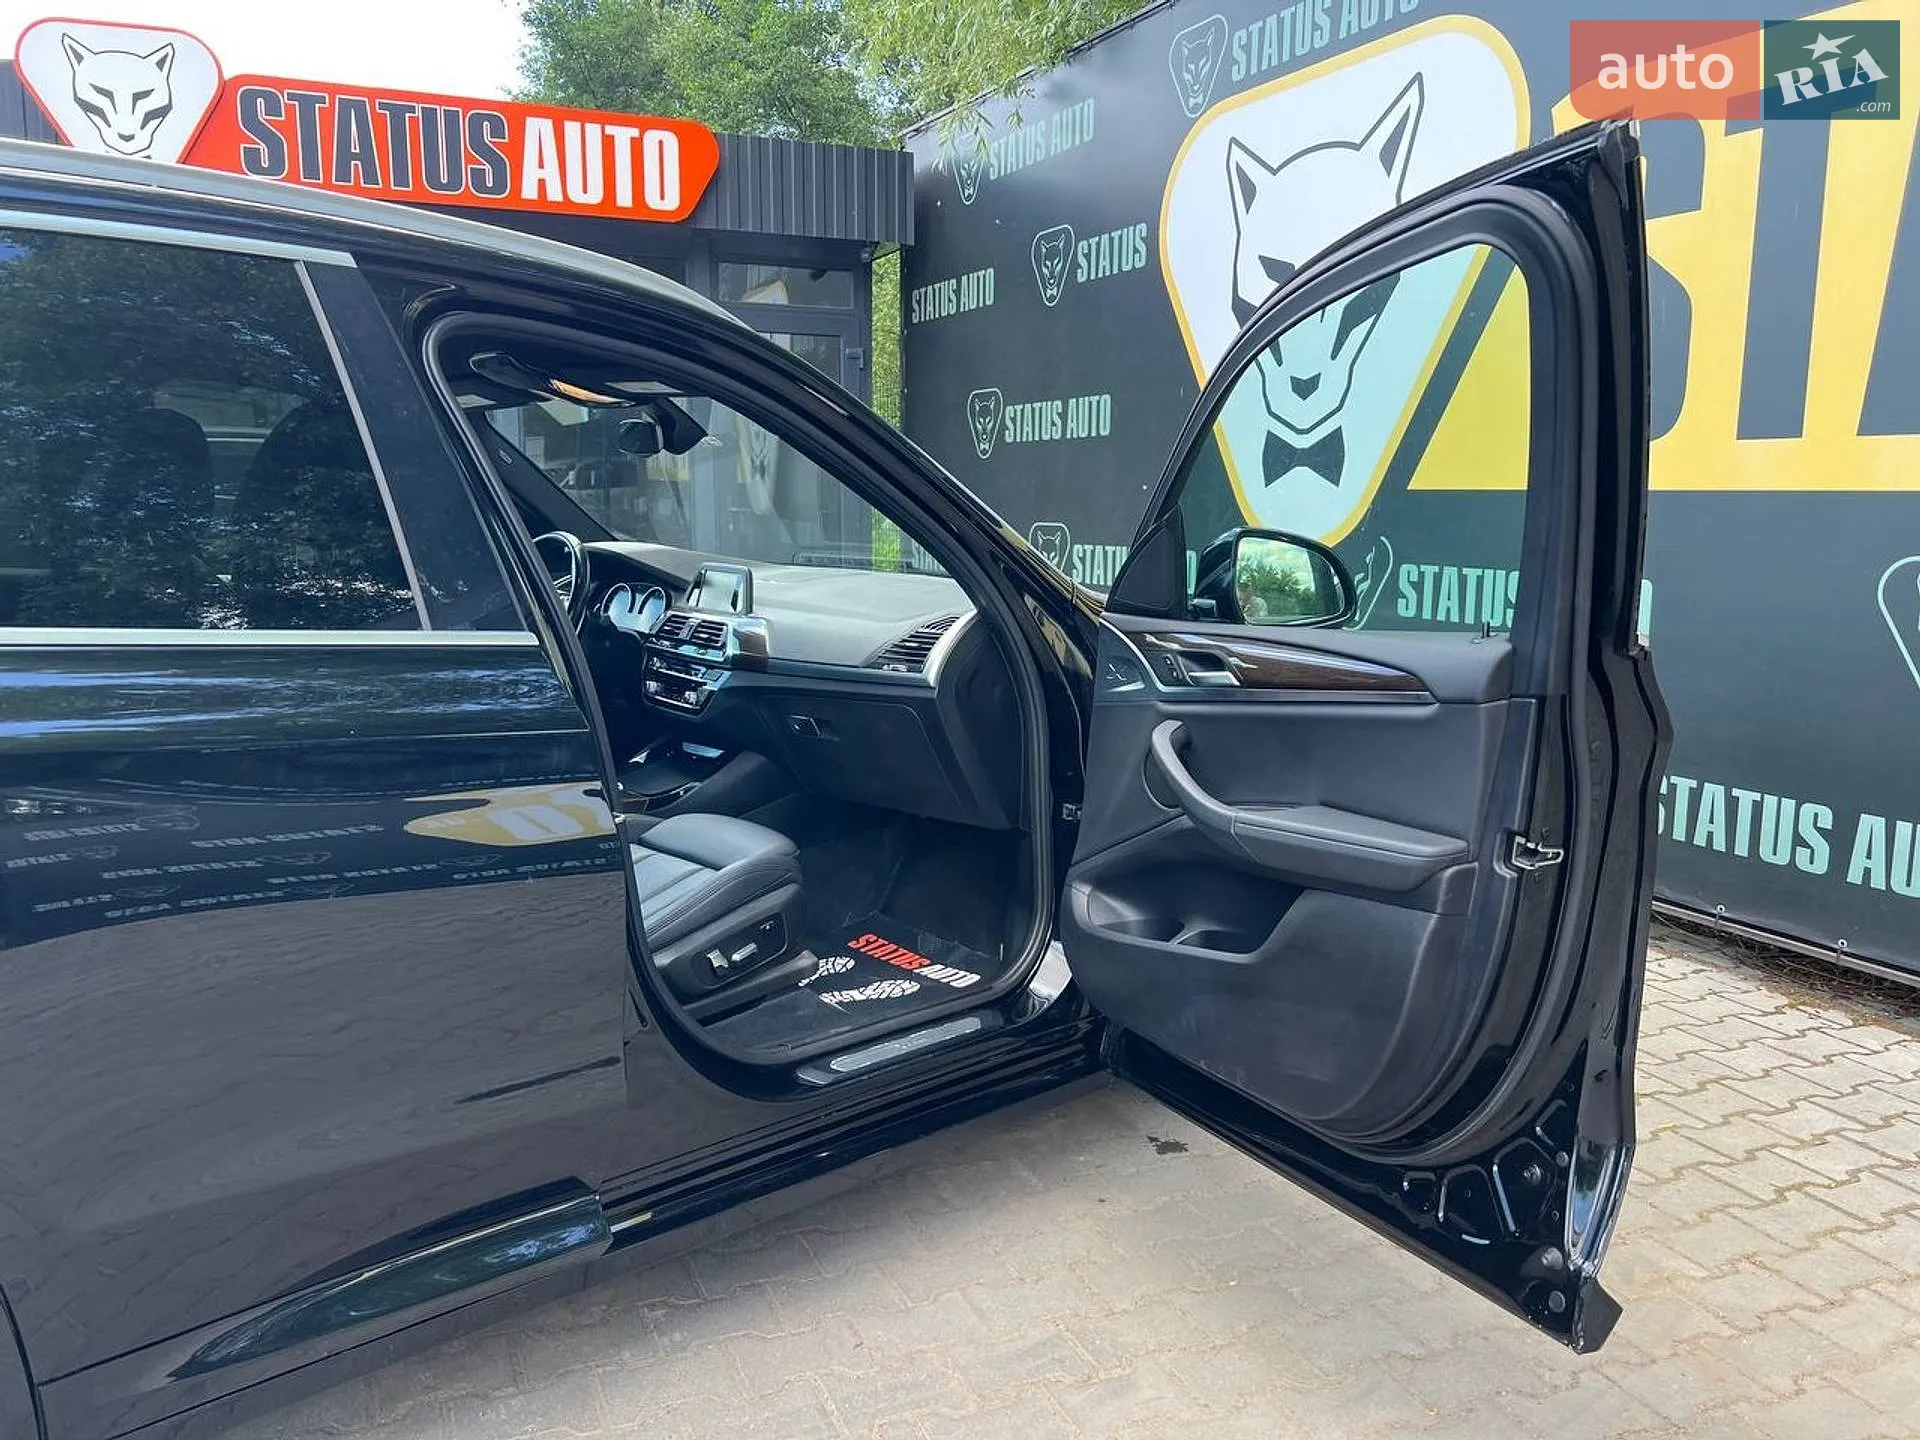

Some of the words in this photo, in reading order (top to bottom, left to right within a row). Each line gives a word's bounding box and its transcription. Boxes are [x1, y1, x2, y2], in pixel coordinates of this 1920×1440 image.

[1231, 0, 1333, 82] STATUS
[237, 86, 511, 199] STATUS
[520, 116, 681, 212] AUTO
[989, 119, 1045, 181] STATUS
[1050, 98, 1095, 158] AUTO
[1076, 223, 1148, 284] STATUS
[912, 275, 957, 324] STATUS
[960, 267, 995, 313] AUTO
[1005, 399, 1063, 443] STATUS
[1066, 394, 1112, 439] AUTO
[1846, 813, 1920, 898] AU
[847, 934, 931, 970] STATUS
[912, 964, 981, 988] AUTO
